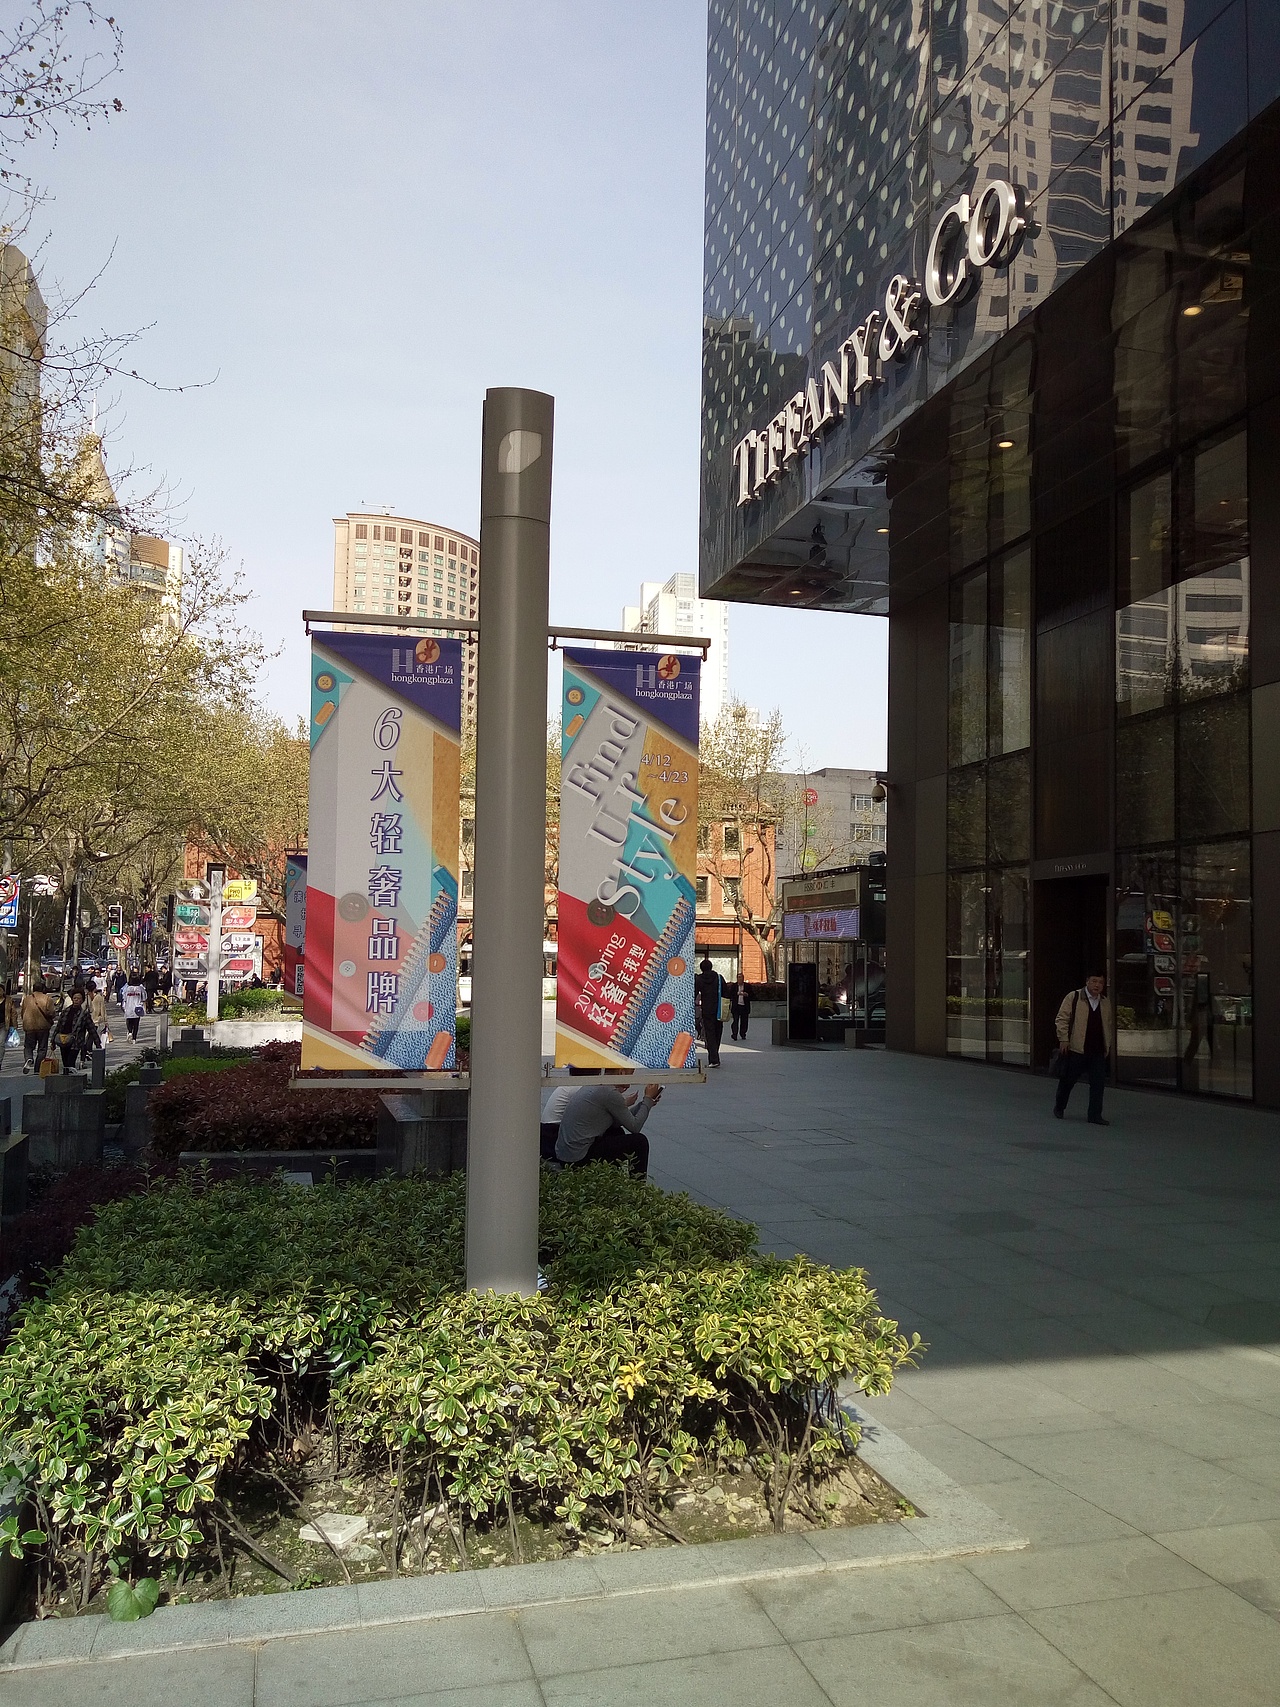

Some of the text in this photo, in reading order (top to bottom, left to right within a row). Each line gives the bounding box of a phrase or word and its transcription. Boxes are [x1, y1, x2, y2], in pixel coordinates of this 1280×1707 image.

[733, 309, 882, 507] TIFFANY
[878, 273, 922, 362] &
[416, 664, 454, 675] 香港广场
[391, 672, 454, 685] hongkongplaza
[658, 680, 693, 691] 香港广场
[635, 688, 693, 701] hongkongplaza
[563, 705, 639, 807] Find
[641, 753, 672, 767] 4/12
[596, 798, 688, 921] Style
[574, 932, 627, 1014] 2017 Spring
